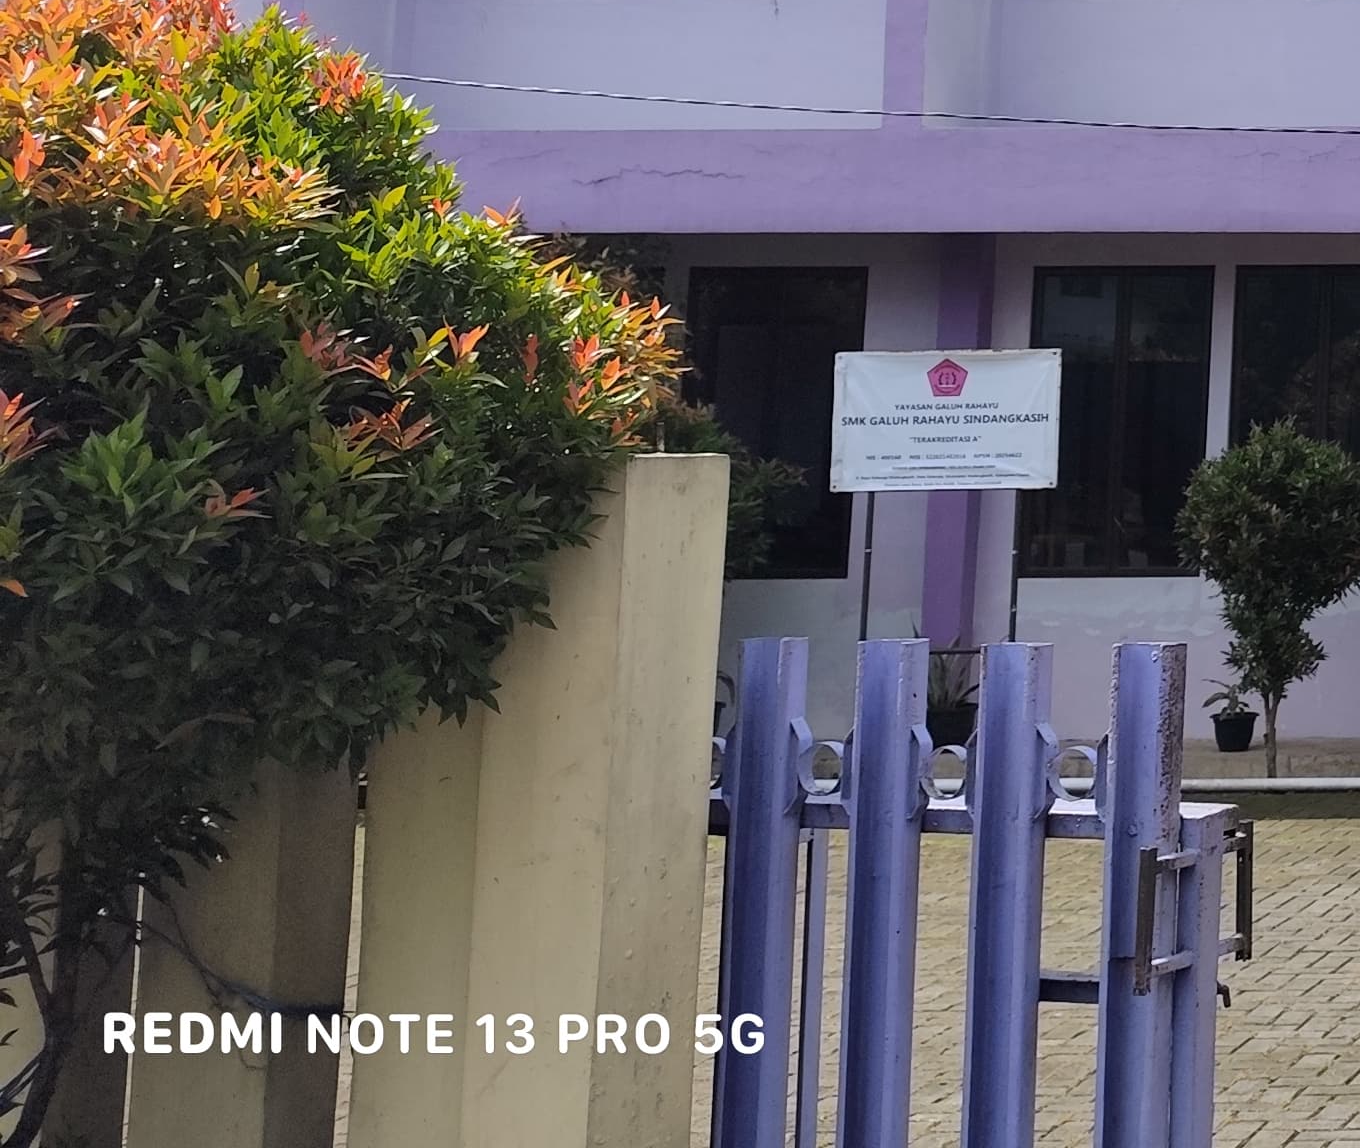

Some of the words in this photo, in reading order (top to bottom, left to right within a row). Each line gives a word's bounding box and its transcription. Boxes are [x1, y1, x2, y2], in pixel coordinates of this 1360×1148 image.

[894, 403, 933, 411] YAYASAN
[935, 403, 963, 411] GALUH
[965, 402, 999, 410] RAHAYU
[841, 416, 867, 427] SMK
[869, 415, 909, 426] GALUH
[912, 414, 960, 426] RAHAYU
[963, 412, 1049, 425] SINDANGKASIH
